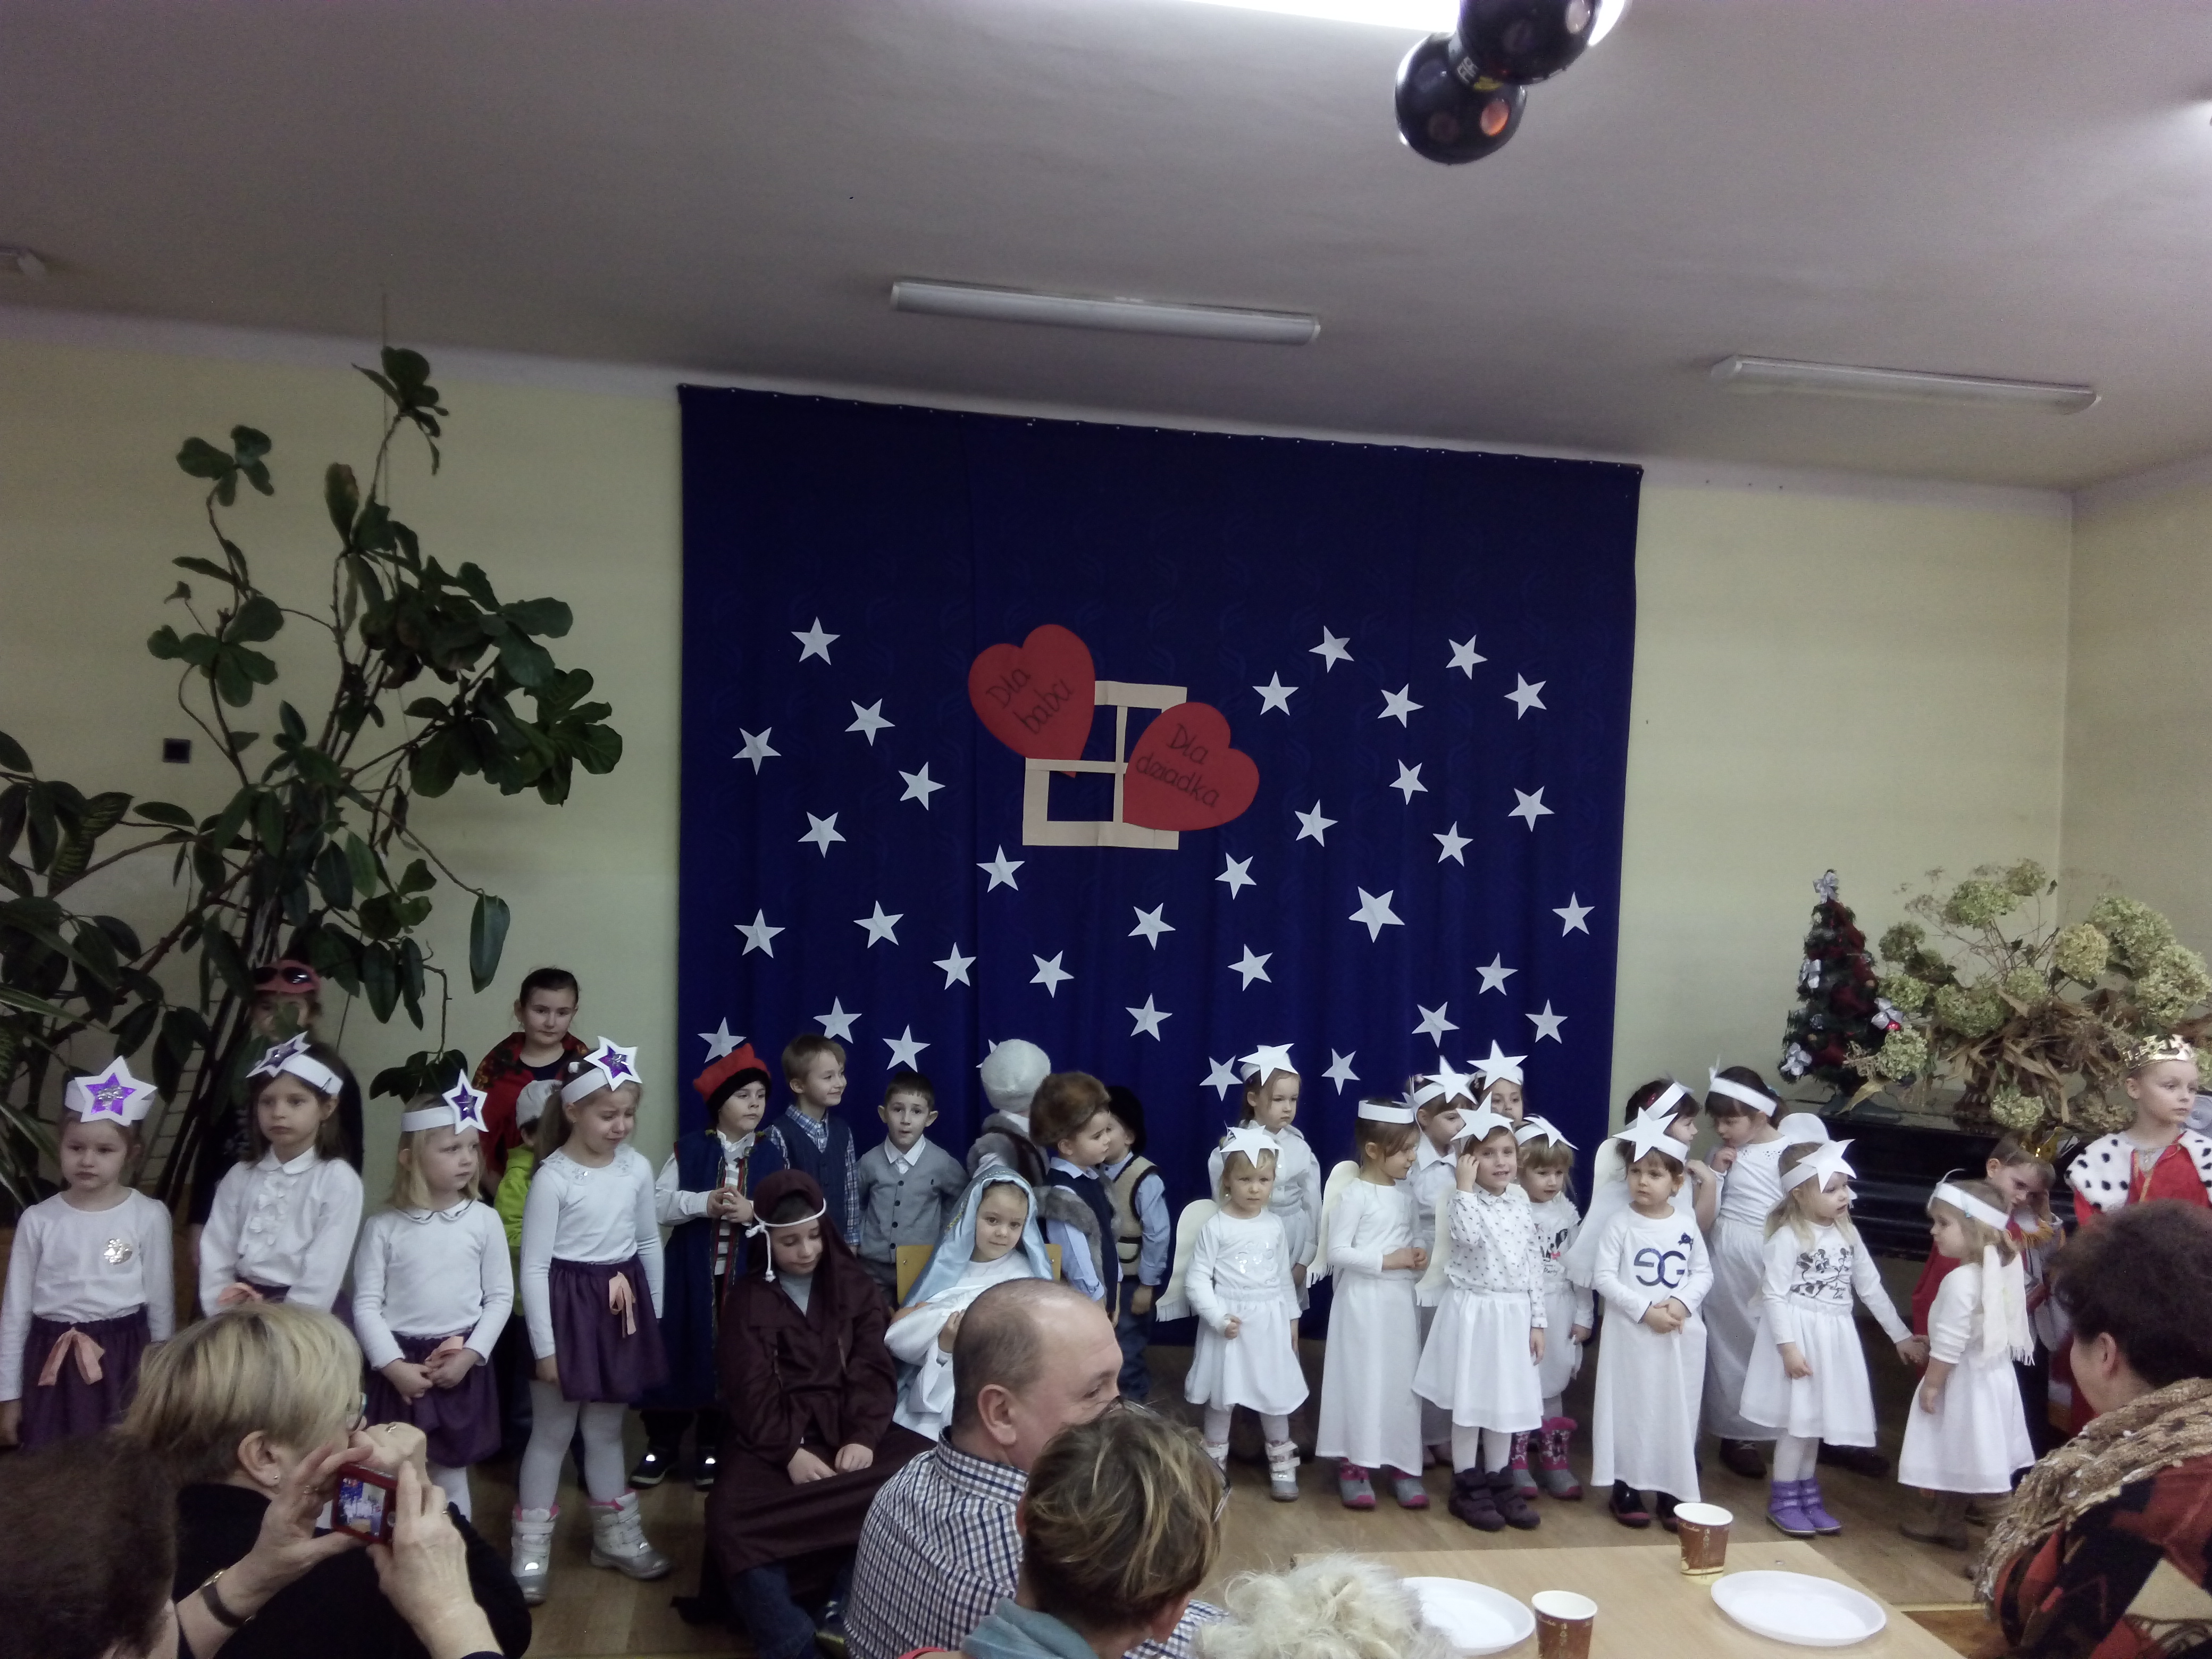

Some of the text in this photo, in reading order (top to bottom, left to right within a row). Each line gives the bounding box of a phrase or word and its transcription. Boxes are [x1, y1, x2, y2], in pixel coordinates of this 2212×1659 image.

[986, 668, 1031, 709] Dla
[1012, 679, 1074, 734] babci
[1166, 723, 1208, 765] Dla
[1136, 752, 1220, 808] dziadka
